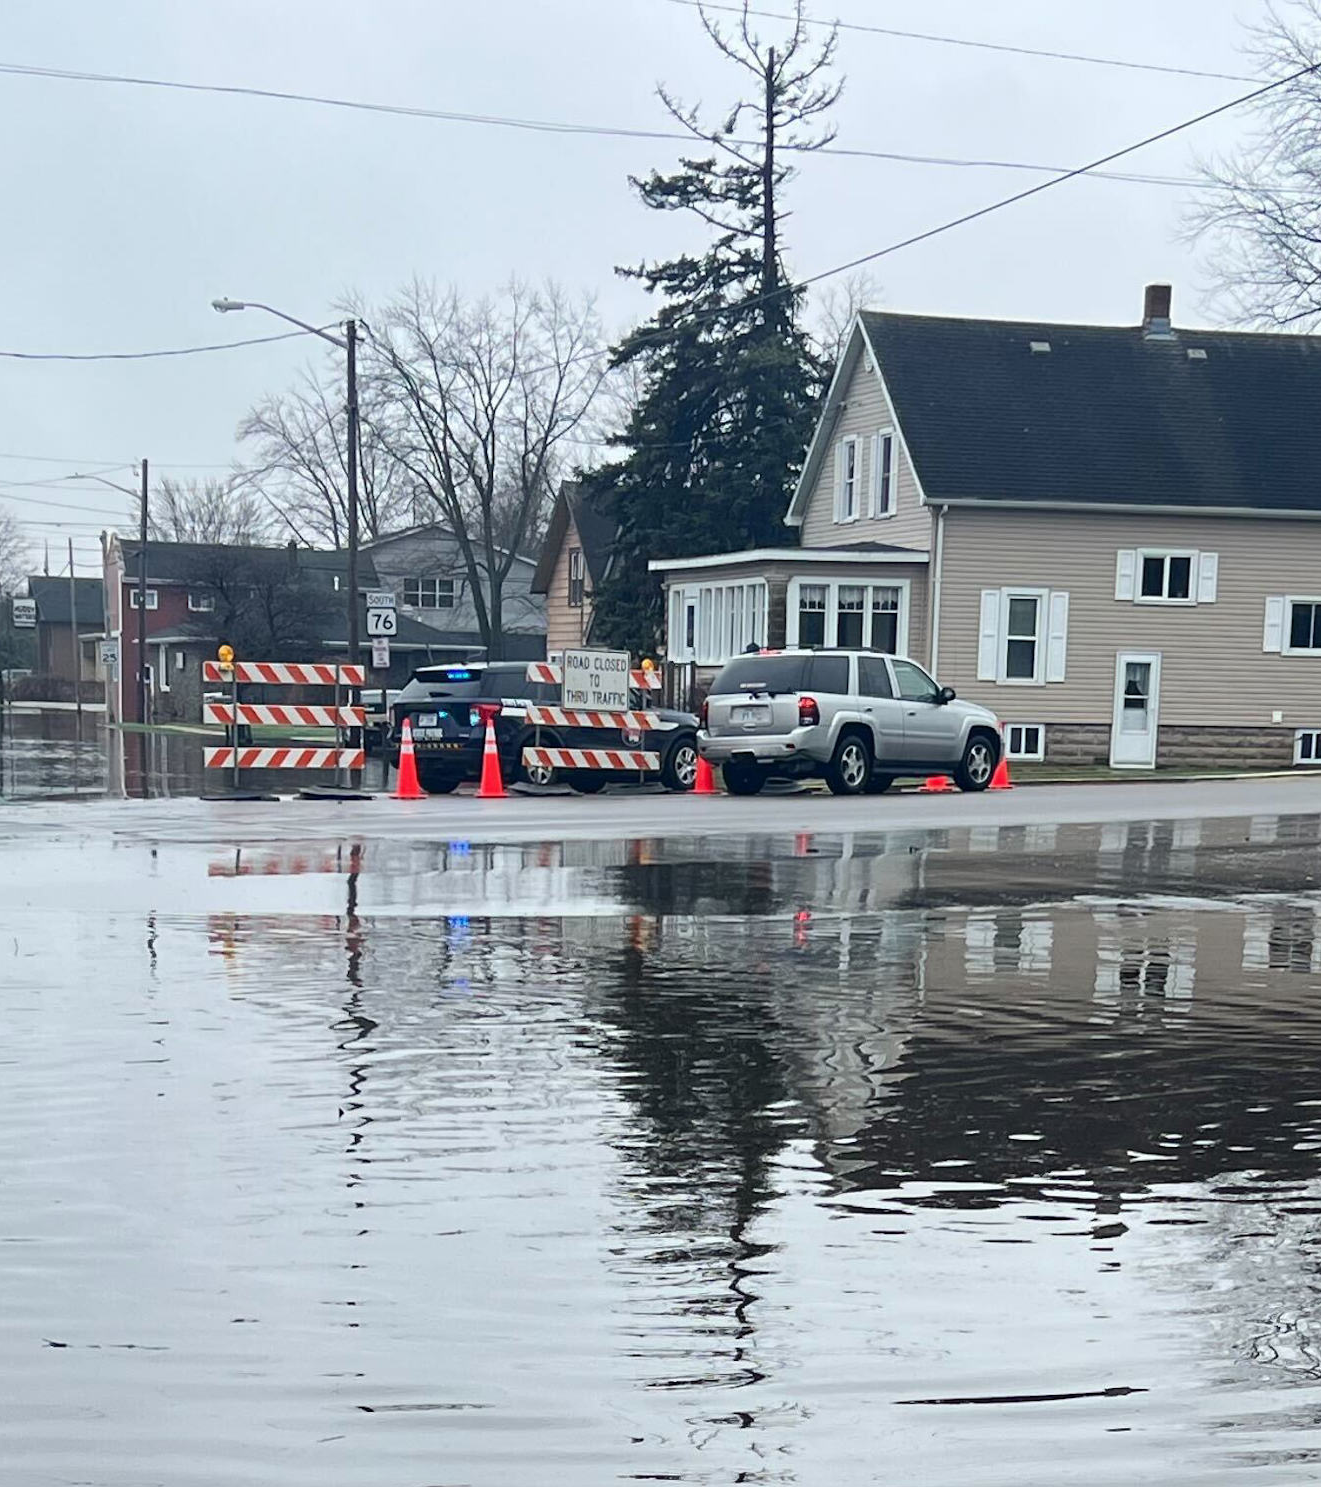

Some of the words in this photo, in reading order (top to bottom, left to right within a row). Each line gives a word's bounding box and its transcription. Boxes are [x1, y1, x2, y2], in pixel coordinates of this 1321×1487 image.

[368, 595, 394, 605] SOUTH
[372, 614, 393, 630] 76
[102, 653, 117, 662] 25
[567, 655, 590, 669] ROAD
[594, 657, 626, 672] CLOSED
[589, 674, 600, 687] TO
[566, 689, 588, 704] THRU
[592, 691, 626, 705] TRAFFIC
